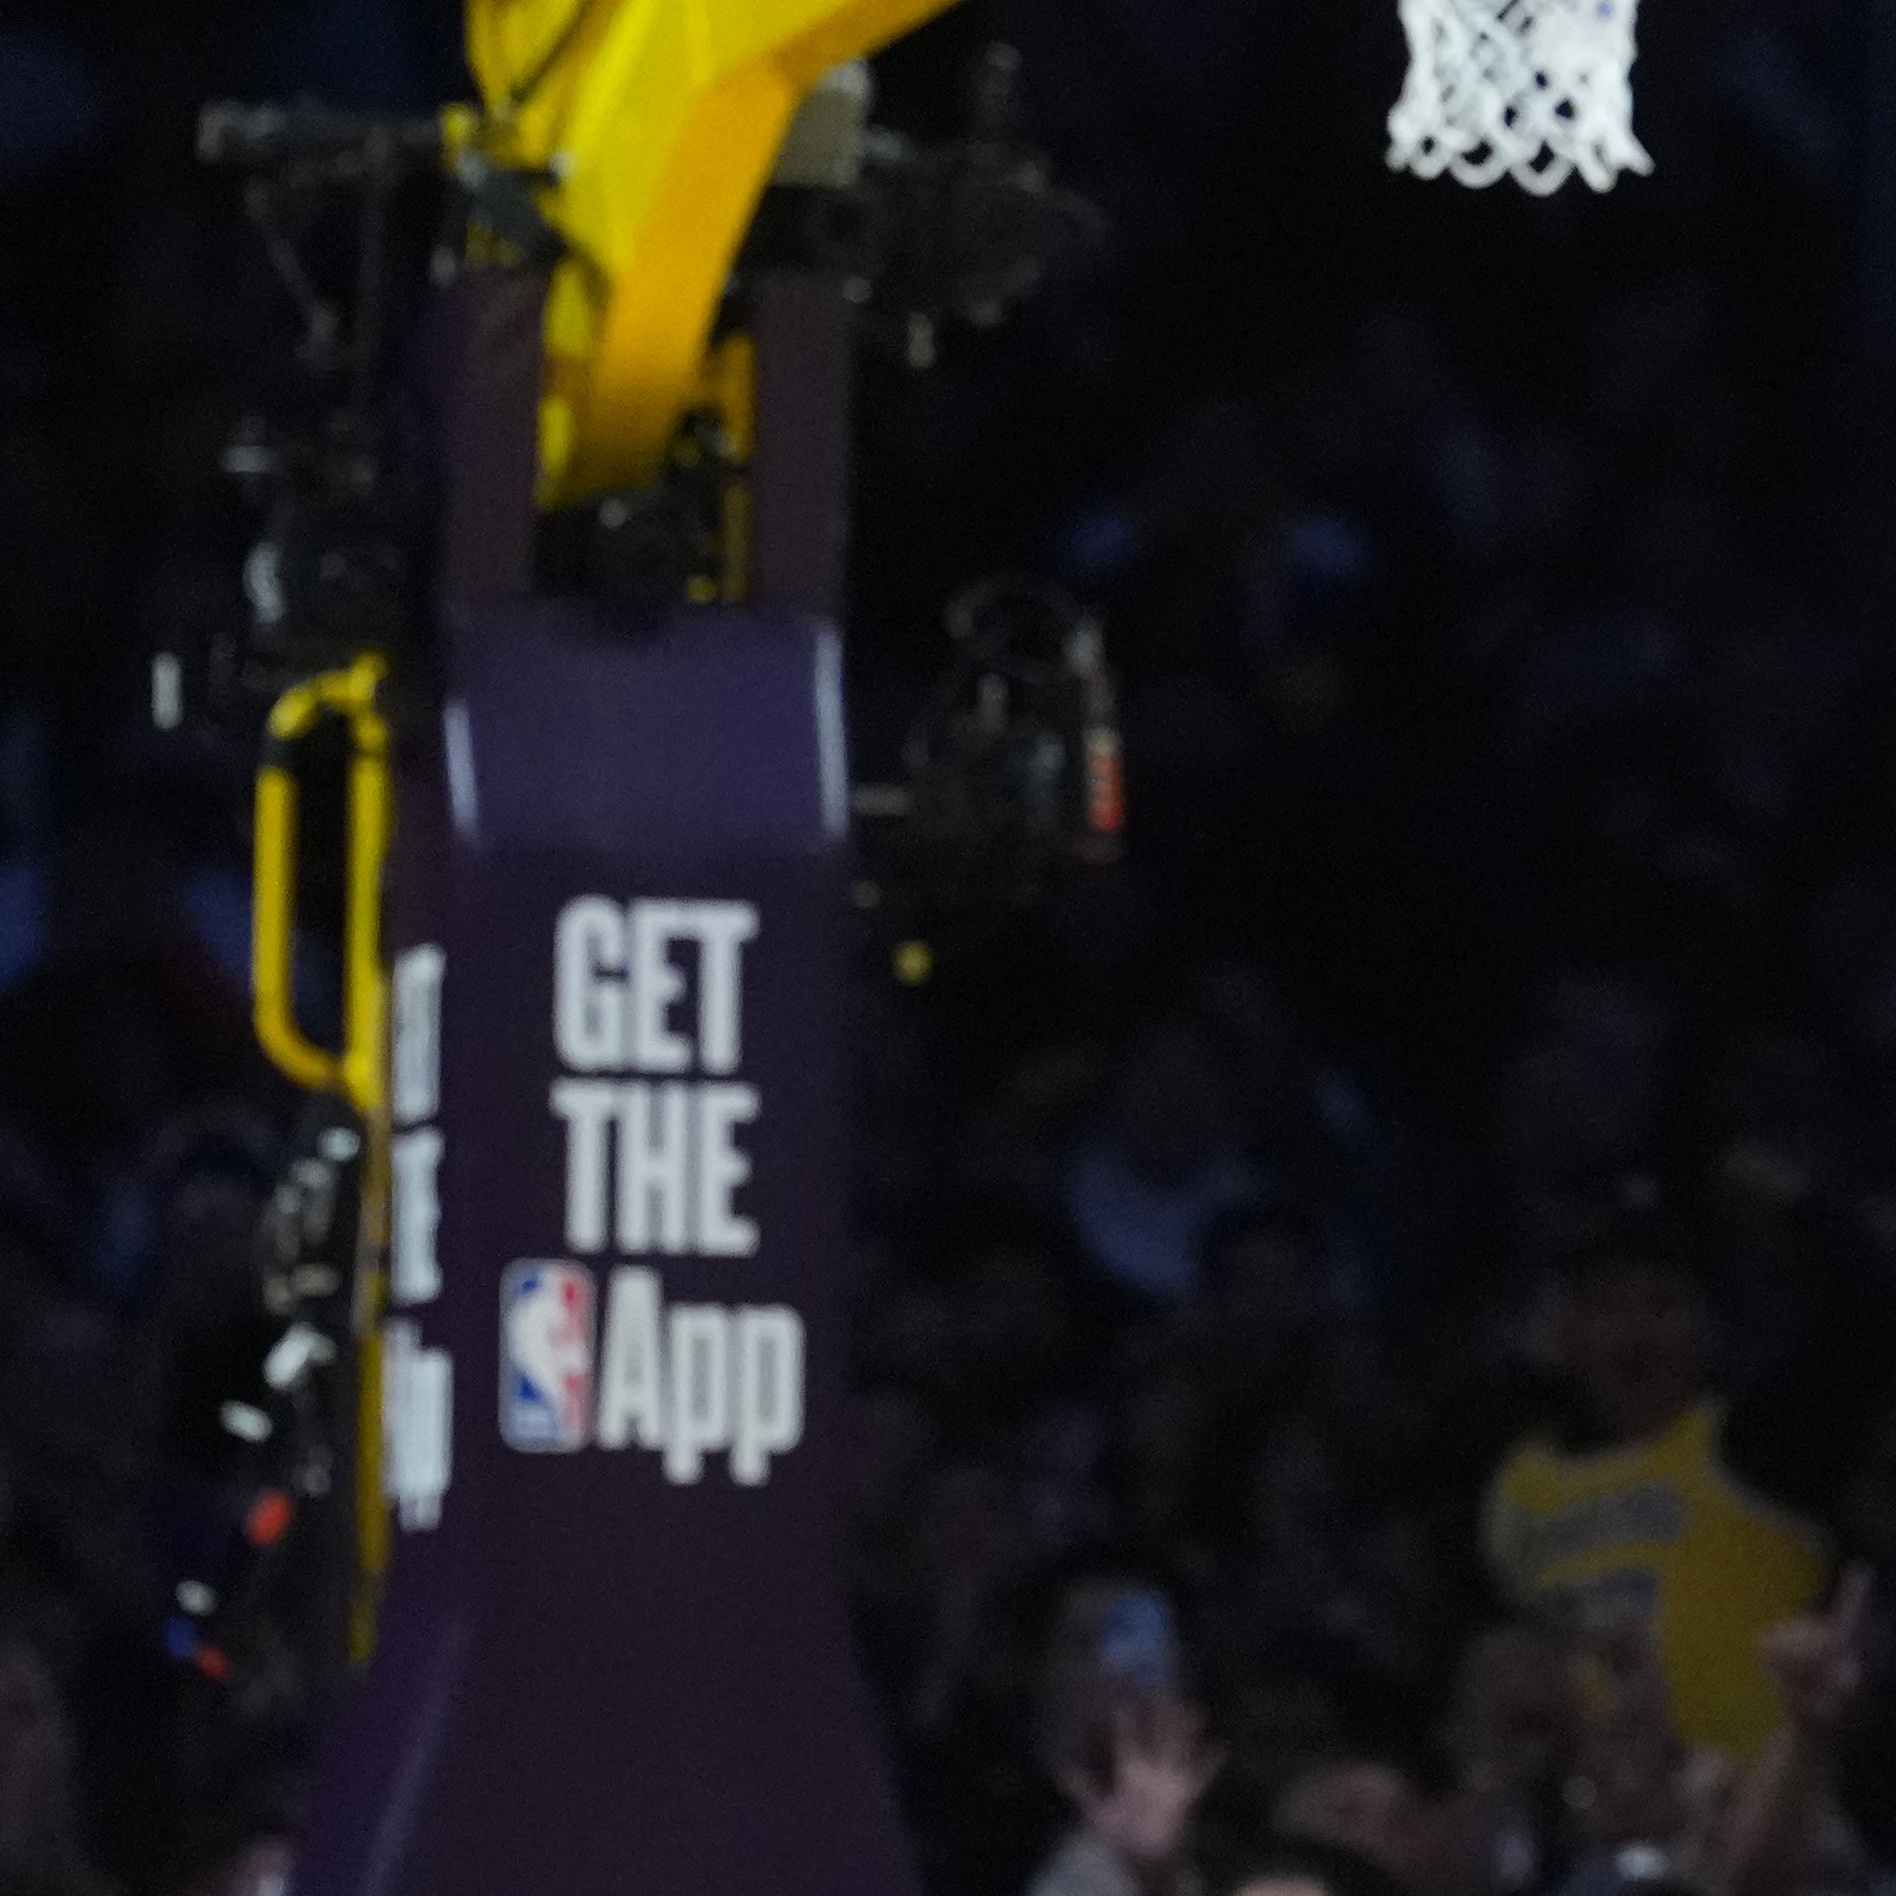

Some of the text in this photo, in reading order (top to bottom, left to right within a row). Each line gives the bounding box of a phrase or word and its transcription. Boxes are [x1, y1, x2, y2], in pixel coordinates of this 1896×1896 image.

[553, 894, 760, 1075] GET
[549, 1078, 760, 1258] THE
[598, 1263, 805, 1487] App
